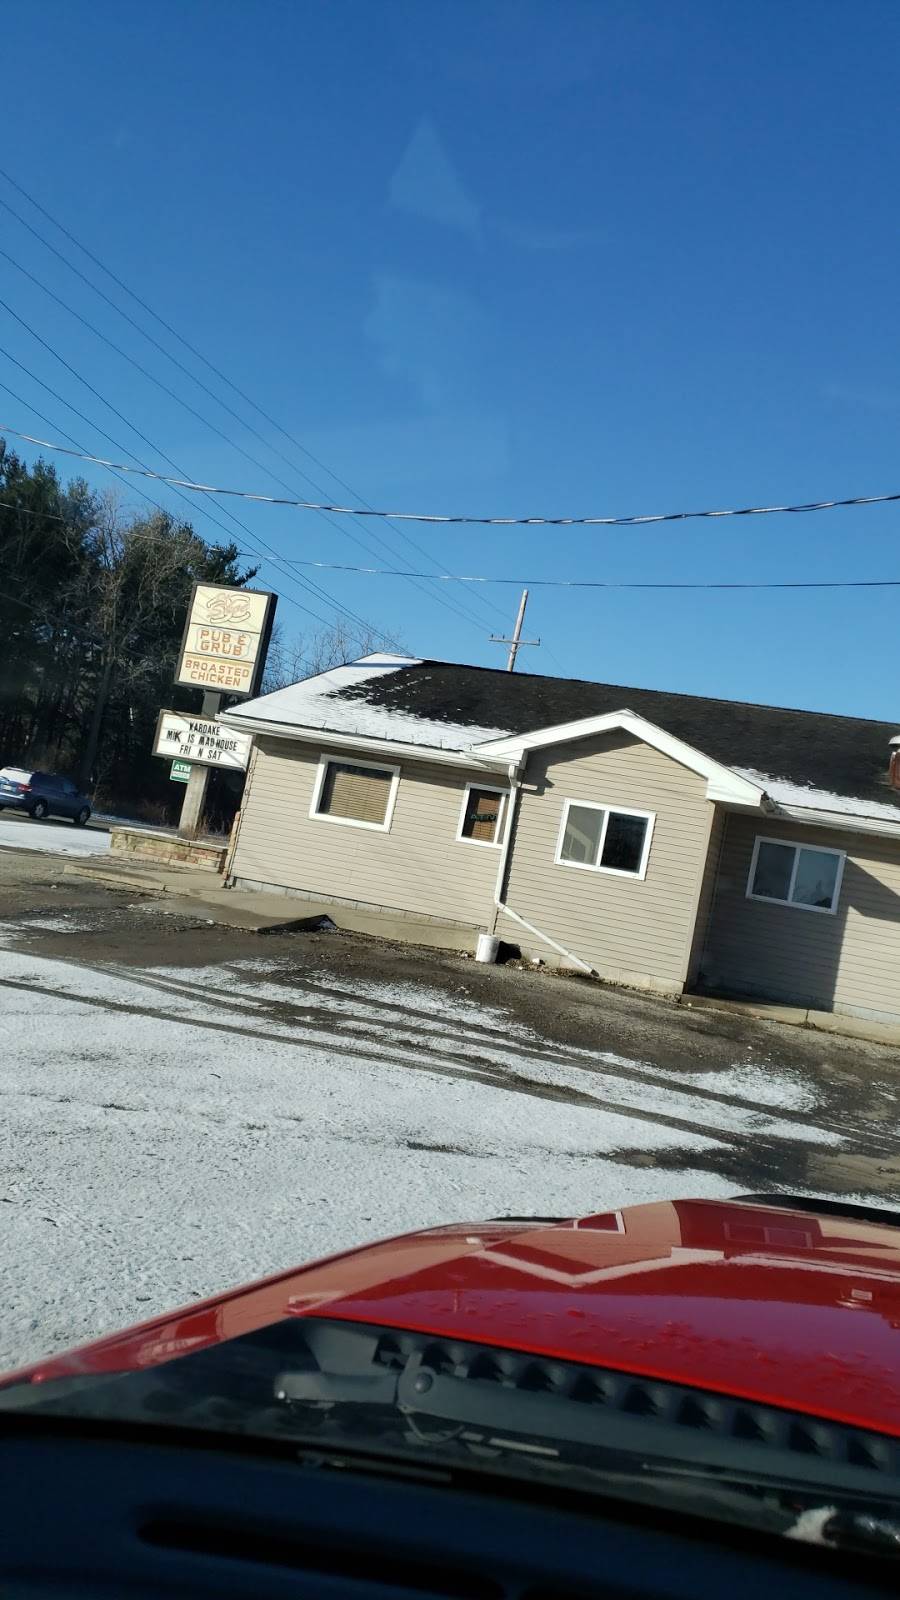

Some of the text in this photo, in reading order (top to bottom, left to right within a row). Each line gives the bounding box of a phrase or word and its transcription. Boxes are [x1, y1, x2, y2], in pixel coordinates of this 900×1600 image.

[200, 629, 231, 643] PUB
[200, 641, 242, 656] GRUB
[185, 659, 250, 678] BROASTED
[190, 670, 241, 687] CHICKEN
[187, 734, 195, 743] IS
[179, 744, 223, 760] FRI N SAT
[173, 763, 191, 773] ATM
